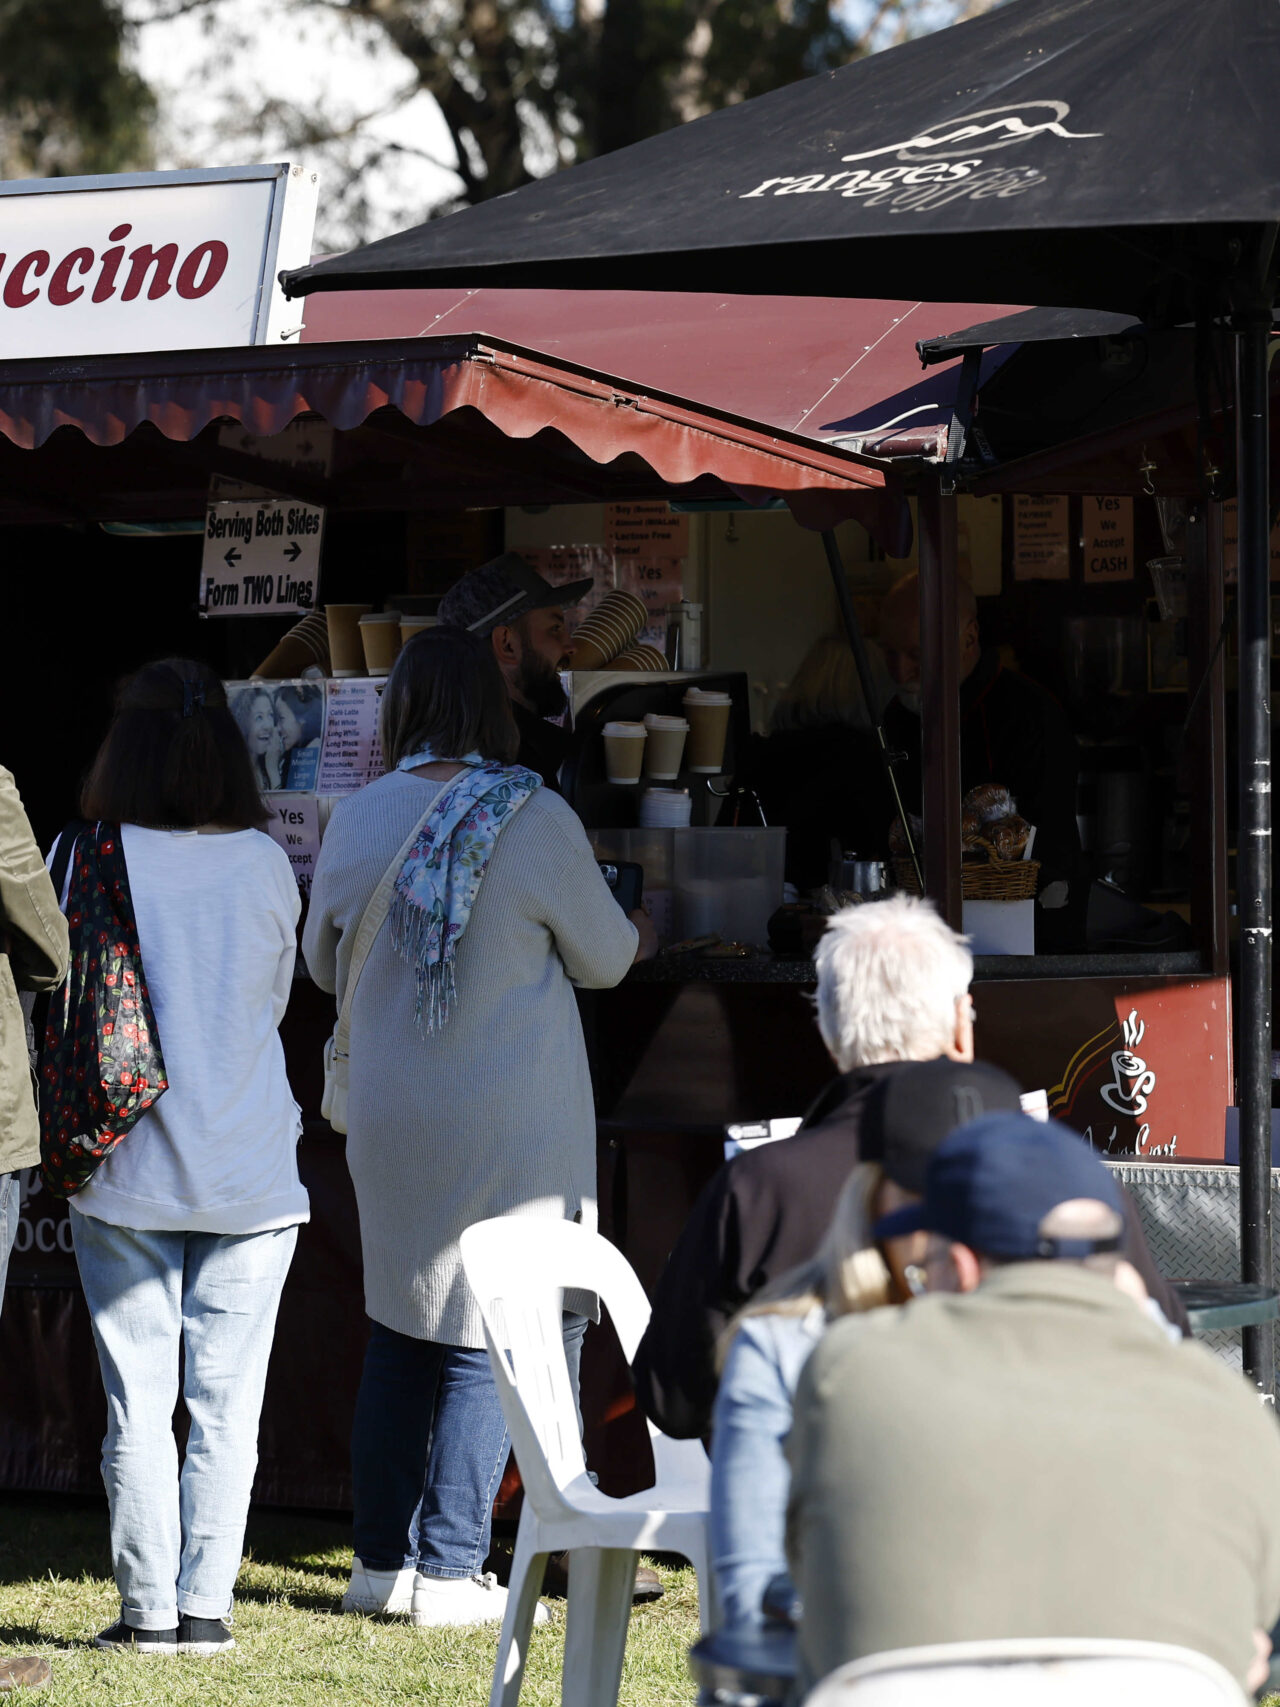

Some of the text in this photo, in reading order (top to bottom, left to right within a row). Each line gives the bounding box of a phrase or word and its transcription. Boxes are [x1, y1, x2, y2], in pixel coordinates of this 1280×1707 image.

[738, 159, 983, 198] ranges
[862, 165, 1047, 214] coffee
[1096, 497, 1120, 511] Yes
[208, 508, 320, 544] Serving Both Sides
[1100, 520, 1117, 530] We
[1093, 537, 1125, 549] Accept
[638, 565, 662, 580] Yes
[1091, 557, 1127, 573] CASH
[206, 574, 313, 606] Form TWO Lines
[326, 740, 341, 749] Long
[279, 808, 304, 824] Yes
[286, 834, 303, 845] We
[288, 853, 312, 866] ccept
[297, 873, 313, 889] SH
